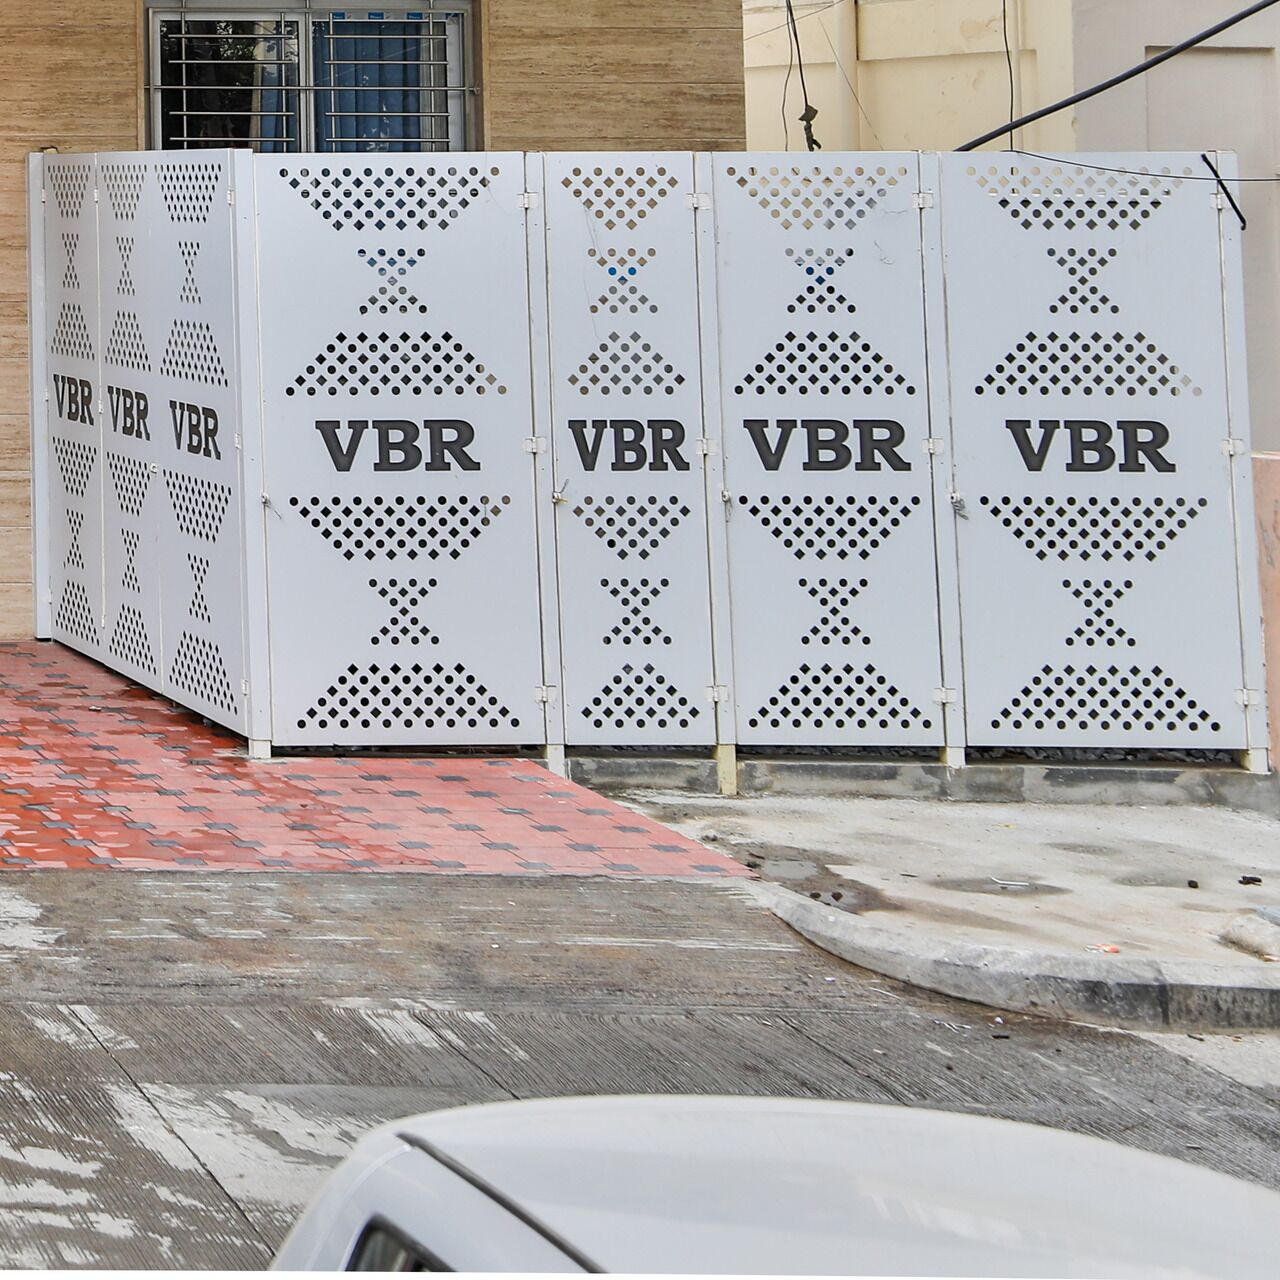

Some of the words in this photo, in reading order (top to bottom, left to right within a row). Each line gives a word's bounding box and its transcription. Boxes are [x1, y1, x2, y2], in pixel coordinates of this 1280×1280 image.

[52, 373, 96, 426] VBR
[107, 385, 151, 442] VBR
[169, 399, 221, 460] VBR
[315, 419, 481, 472] VBR
[568, 419, 691, 472] VBR
[743, 419, 911, 472] VBR
[1005, 419, 1177, 473] VBR
